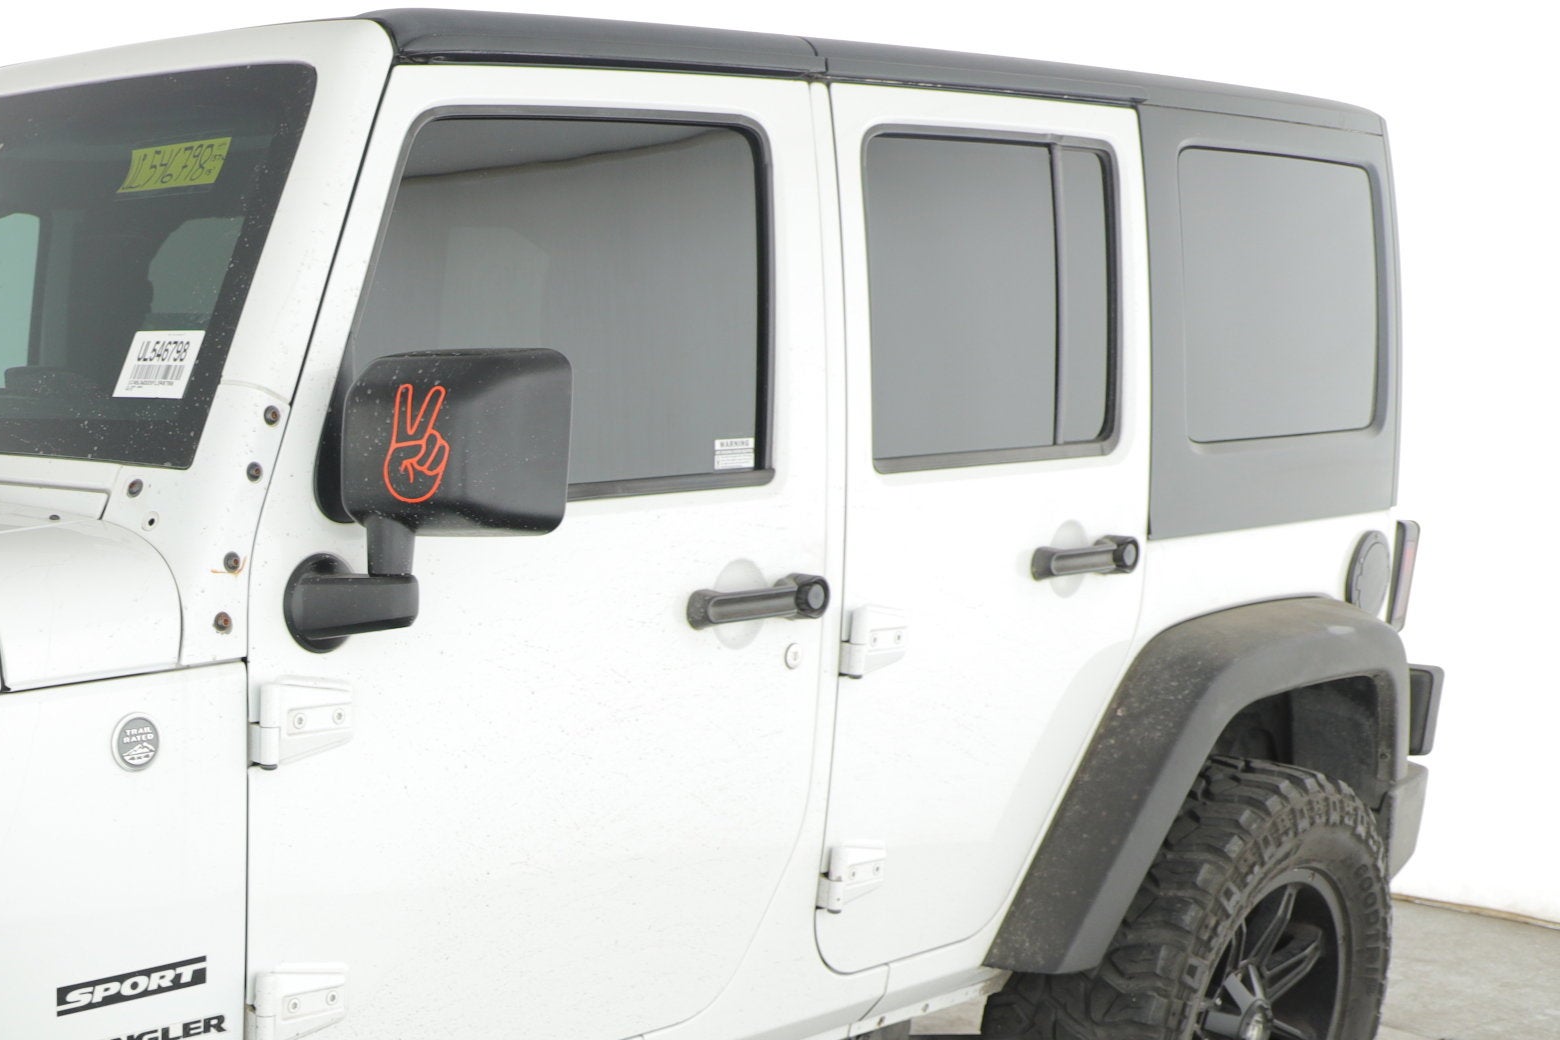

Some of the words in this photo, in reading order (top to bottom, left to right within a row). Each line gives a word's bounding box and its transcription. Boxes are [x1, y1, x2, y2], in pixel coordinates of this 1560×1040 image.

[137, 341, 190, 362] UL546798
[720, 439, 749, 448] WARNING
[125, 726, 152, 736] TRAIL
[123, 734, 154, 743] RATED
[62, 965, 202, 1010] SPORT
